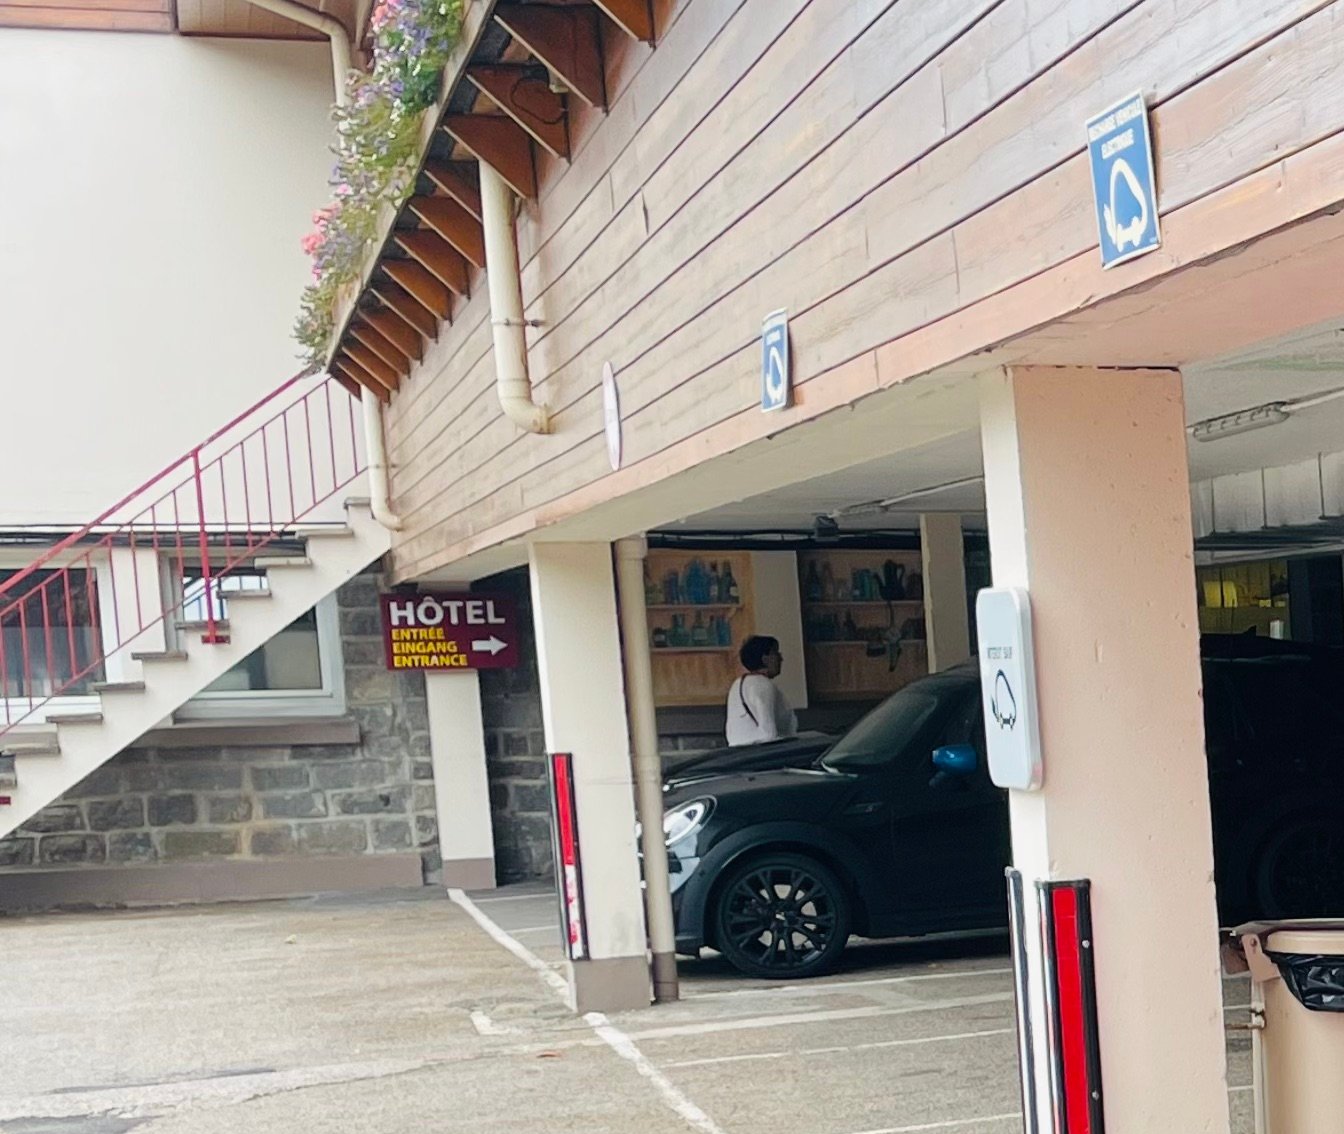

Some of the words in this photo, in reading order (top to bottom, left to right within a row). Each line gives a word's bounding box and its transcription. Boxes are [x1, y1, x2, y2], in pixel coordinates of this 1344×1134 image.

[389, 596, 506, 626] HÔTEL
[392, 627, 445, 641] ENTRÉE
[393, 641, 458, 654] EINGANG
[394, 654, 468, 668] ENTRANCE
